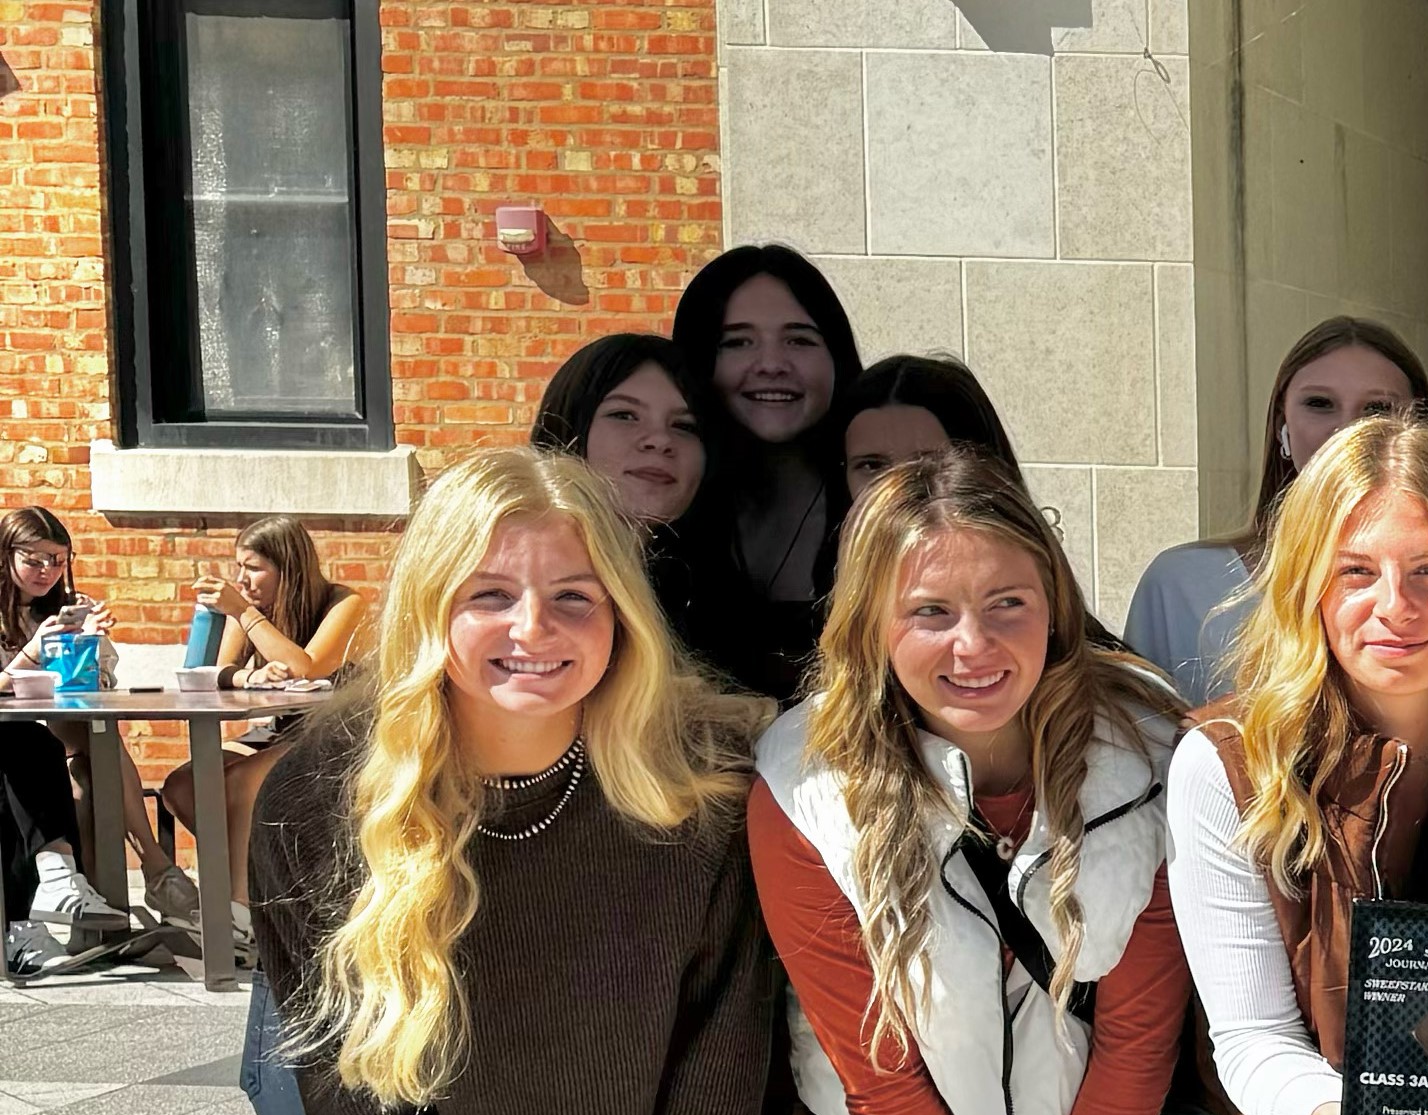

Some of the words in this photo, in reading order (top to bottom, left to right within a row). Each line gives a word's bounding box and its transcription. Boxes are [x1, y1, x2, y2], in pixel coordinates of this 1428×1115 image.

[1368, 937, 1413, 958] 2024
[1363, 991, 1406, 1002] WINNER
[1360, 1072, 1405, 1086] CLASS
[1409, 1075, 1428, 1088] 3A
